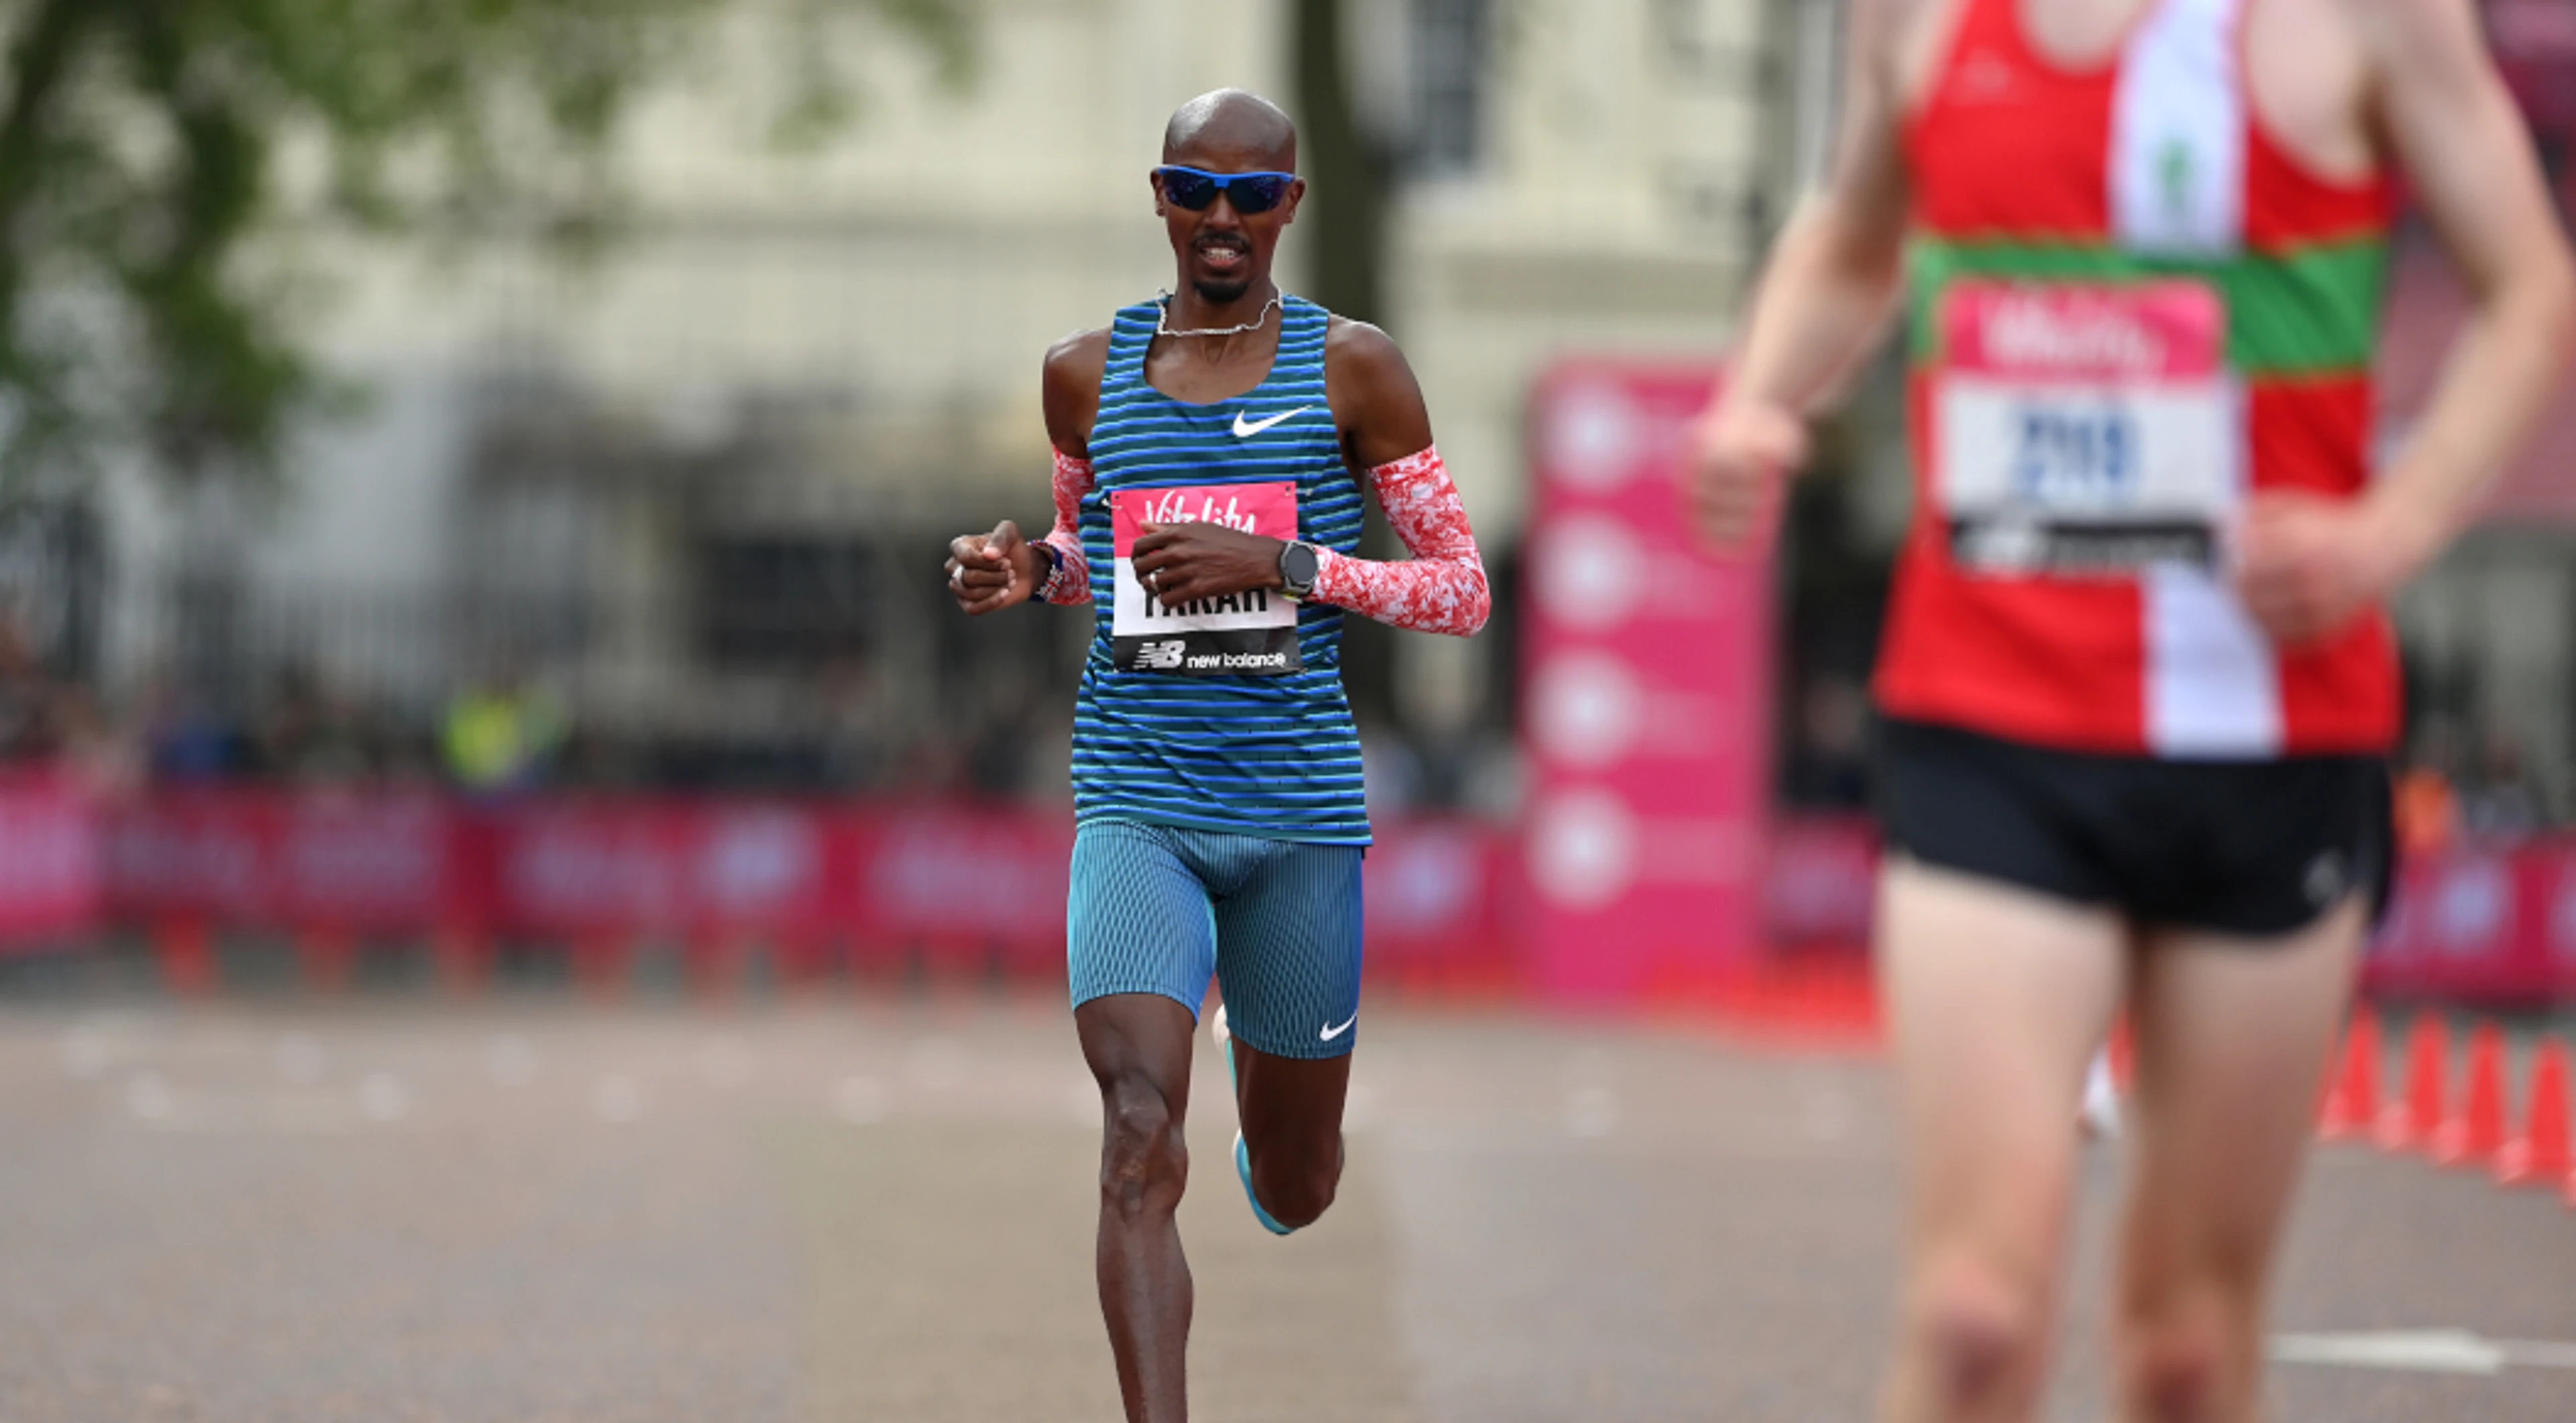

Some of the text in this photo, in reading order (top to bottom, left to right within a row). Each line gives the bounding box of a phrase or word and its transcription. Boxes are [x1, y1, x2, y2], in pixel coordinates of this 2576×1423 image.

[1145, 490, 1256, 535] Vitlity
[1145, 587, 1267, 618] FAH
[1187, 655, 1222, 668] new
[1224, 652, 1286, 668] balance
